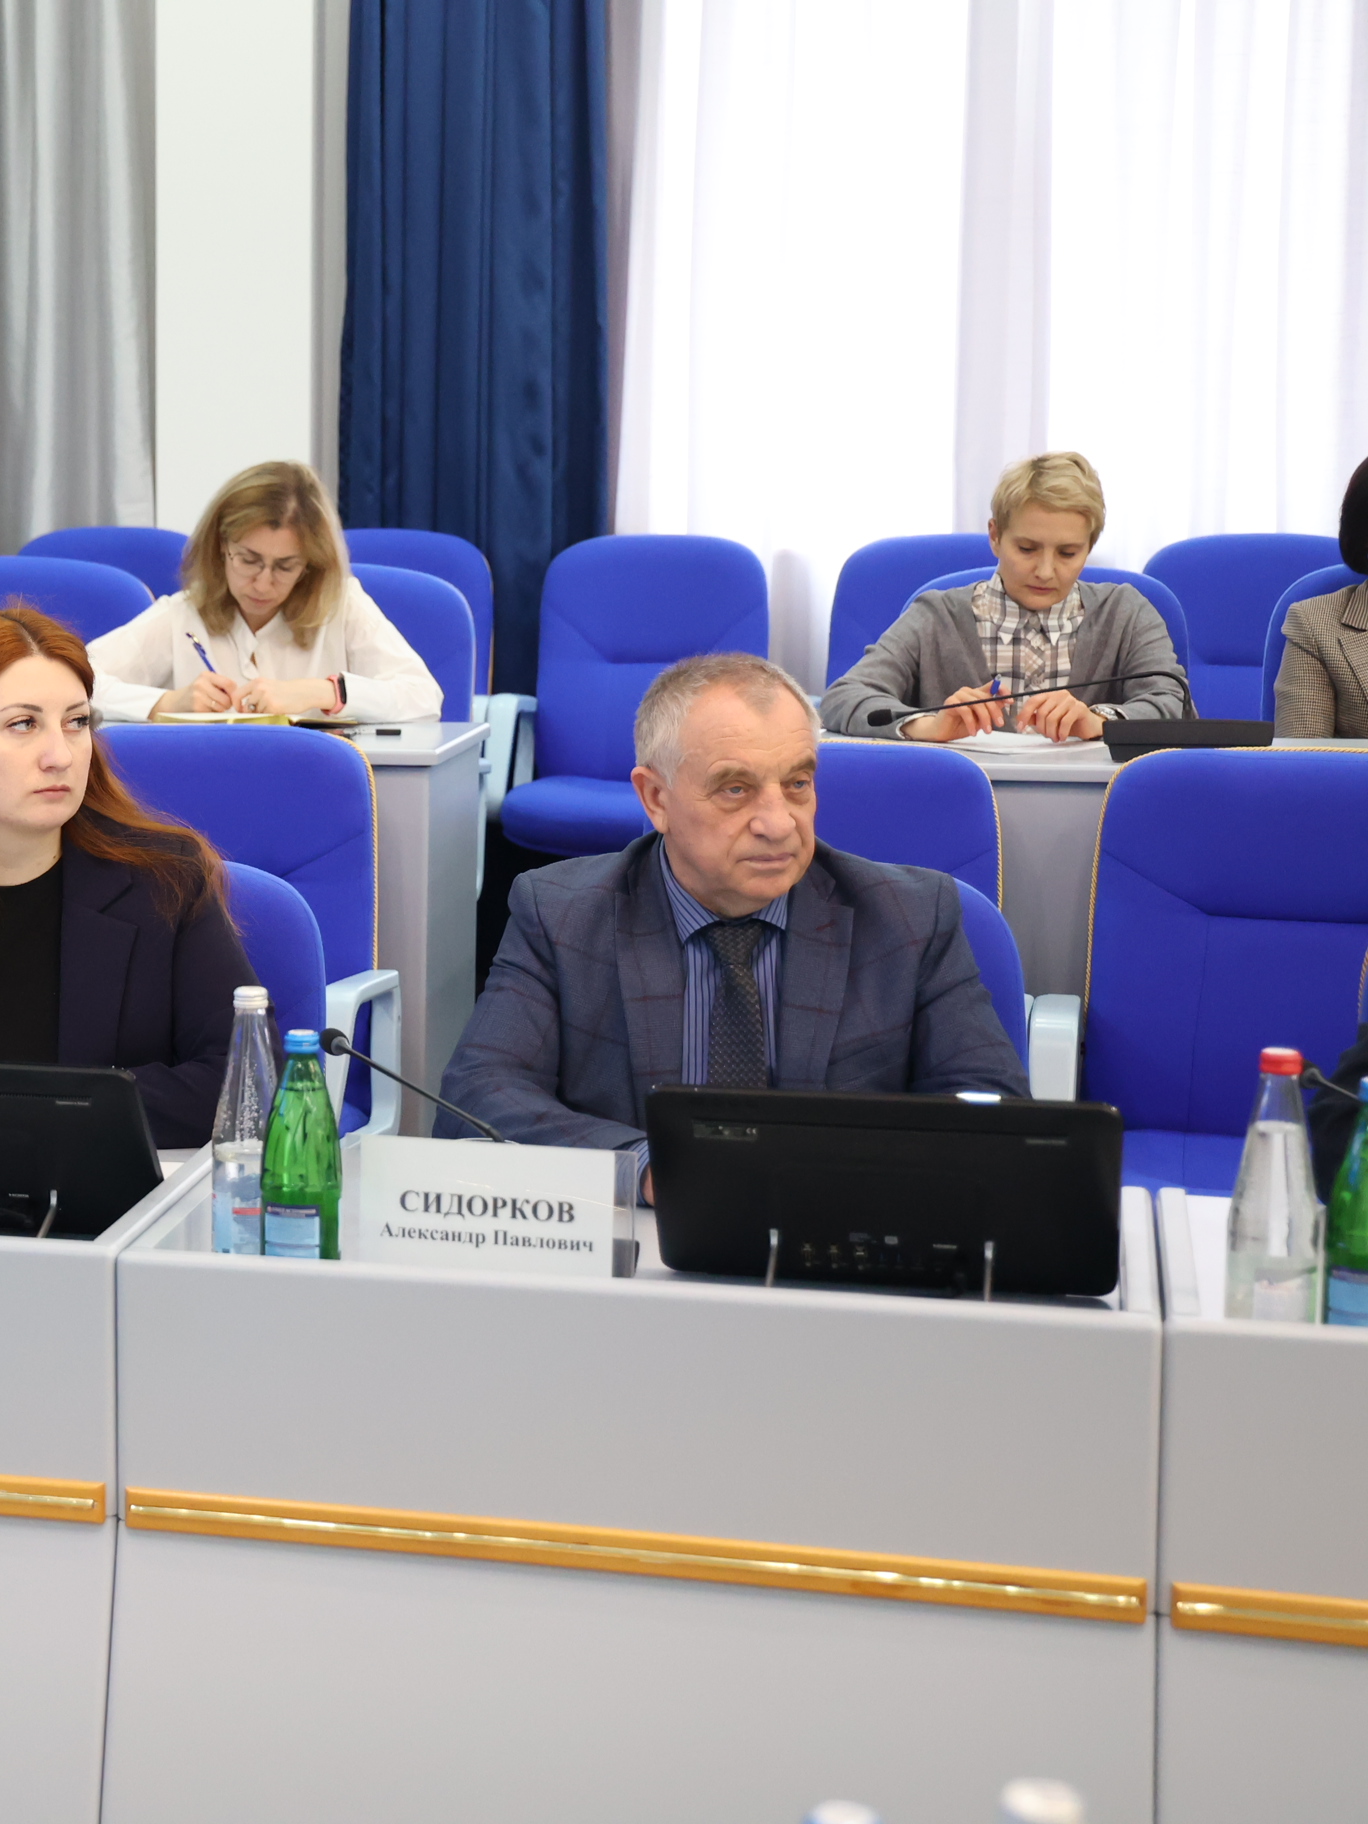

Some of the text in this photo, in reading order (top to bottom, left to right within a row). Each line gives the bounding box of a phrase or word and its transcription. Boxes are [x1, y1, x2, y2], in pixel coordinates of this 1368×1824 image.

[399, 1189, 575, 1224] СИДОРКОВ
[379, 1221, 594, 1253] Александр Павлович
